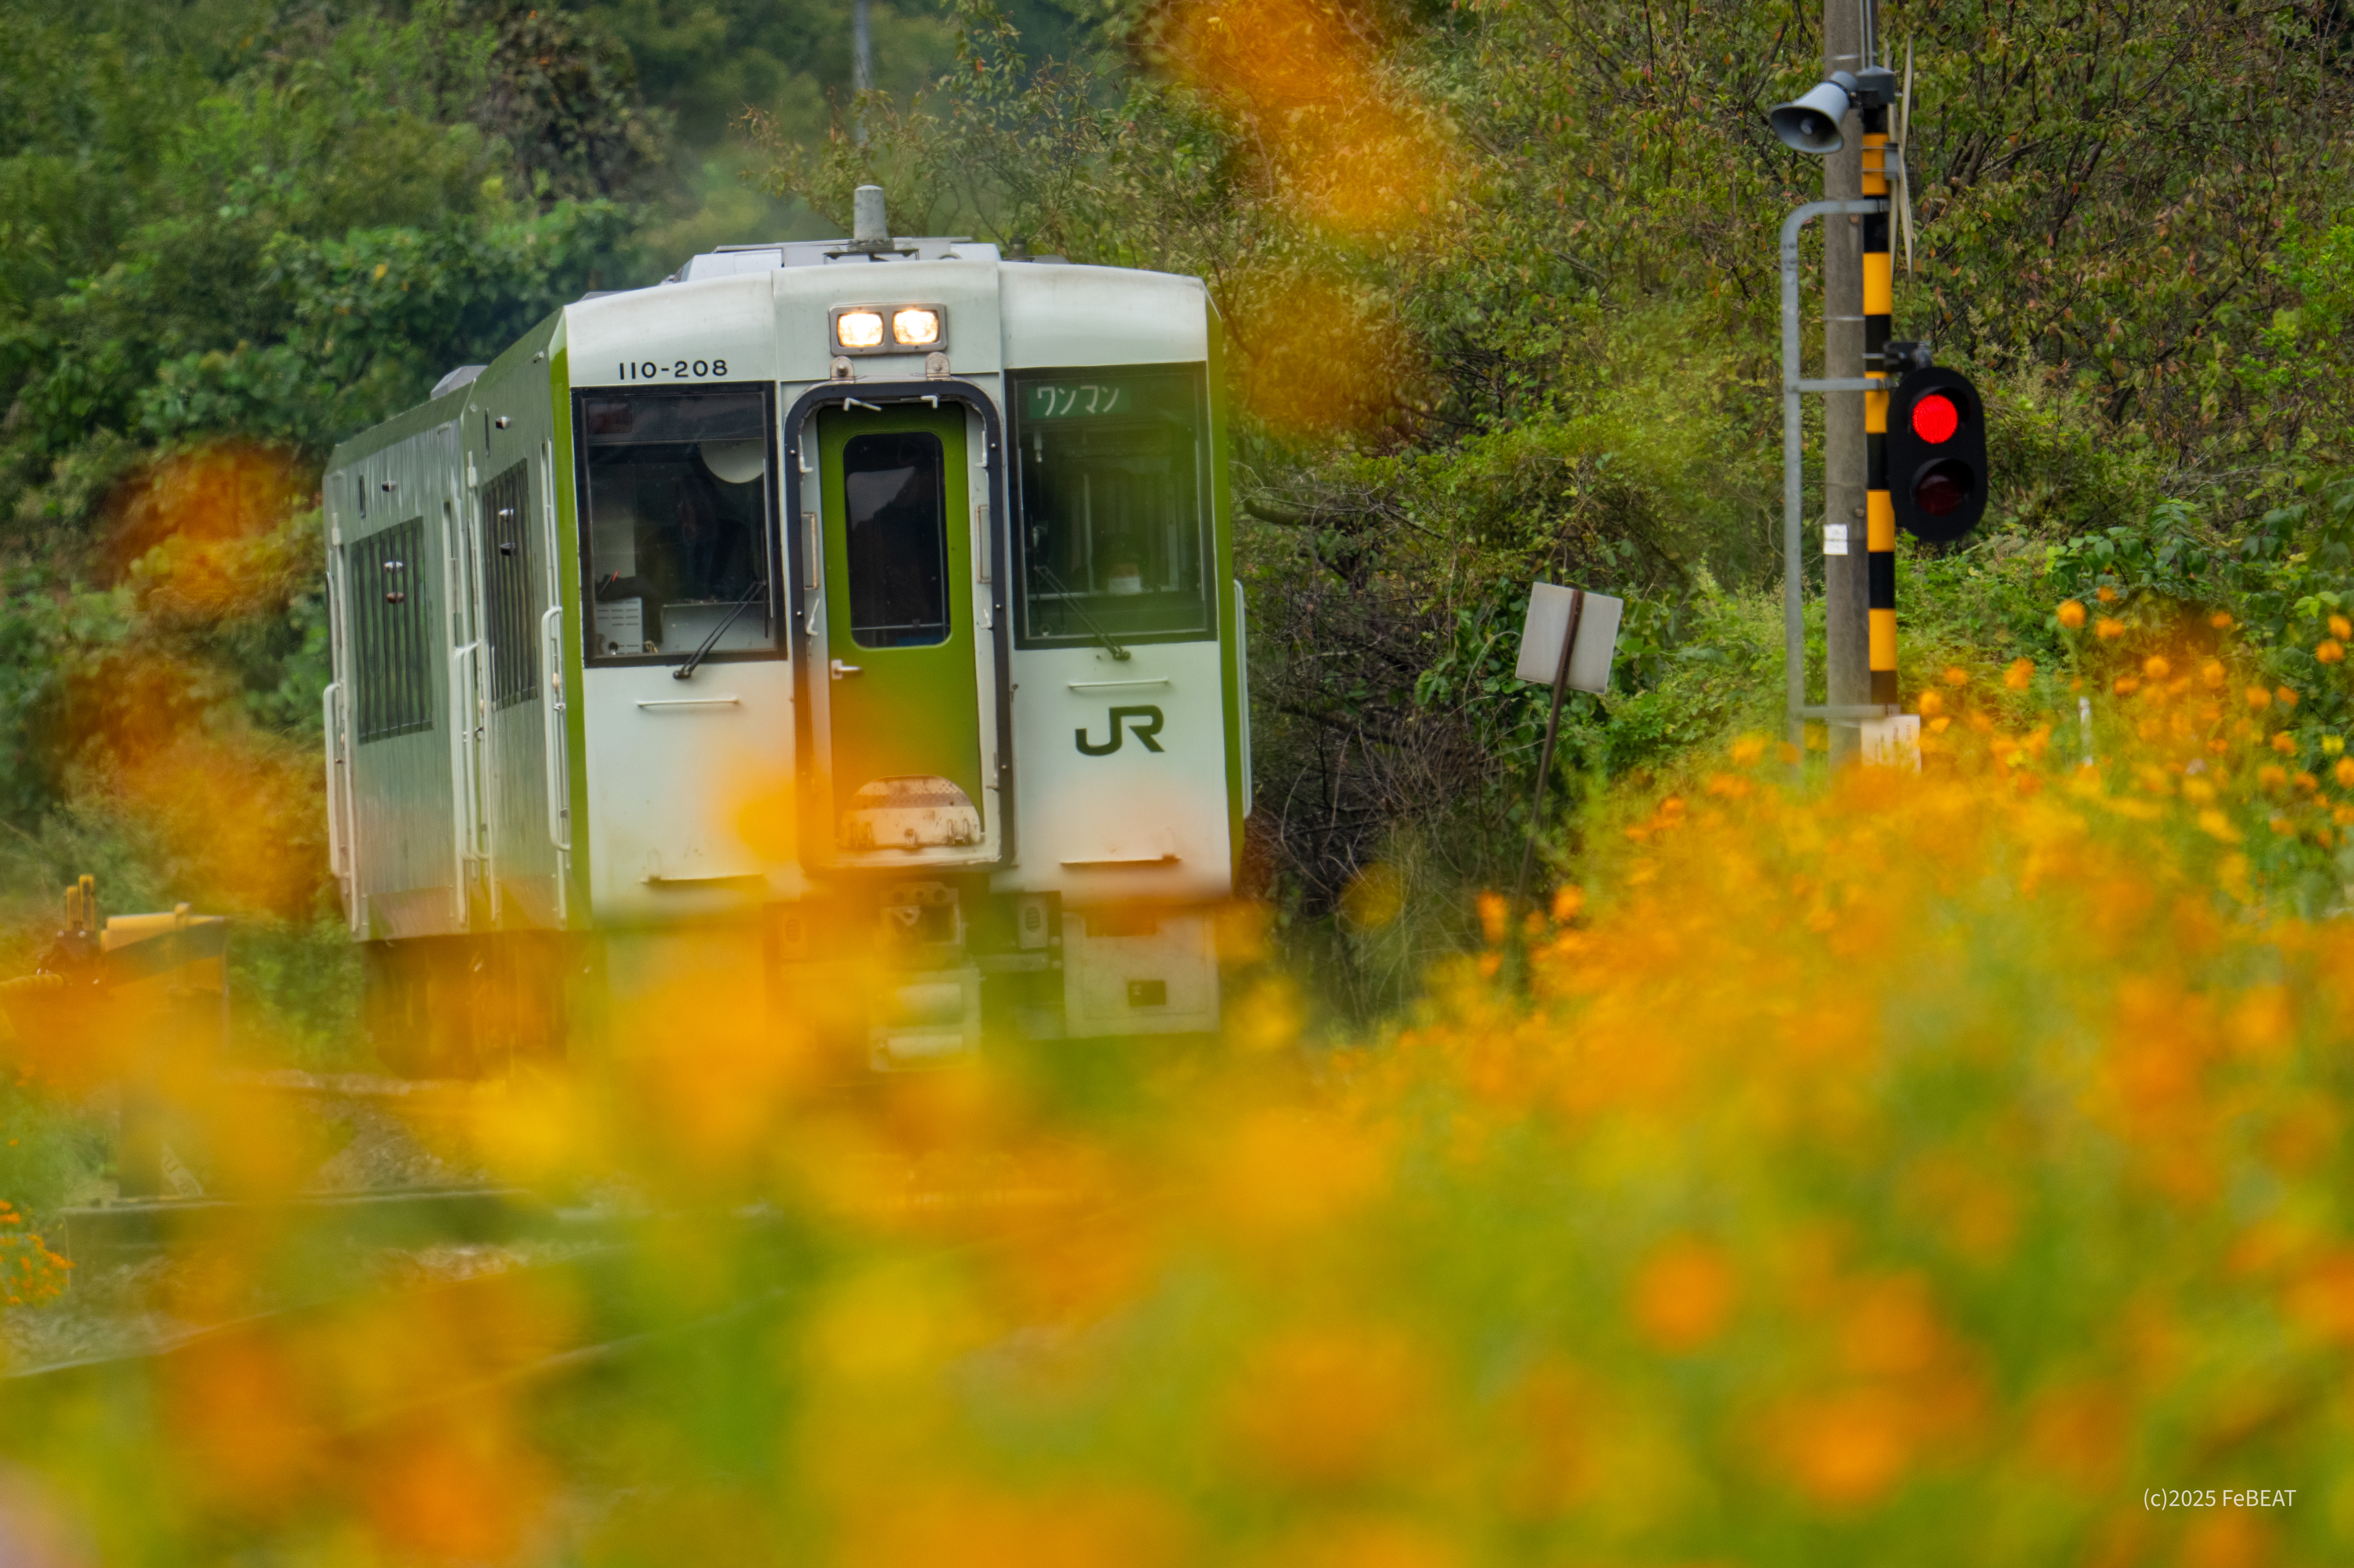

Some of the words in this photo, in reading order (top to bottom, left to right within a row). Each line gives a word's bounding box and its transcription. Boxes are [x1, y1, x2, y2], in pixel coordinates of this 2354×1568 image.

[619, 359, 728, 380] 110-208
[1037, 384, 1120, 416] ワンマン
[1075, 704, 1165, 756] JR
